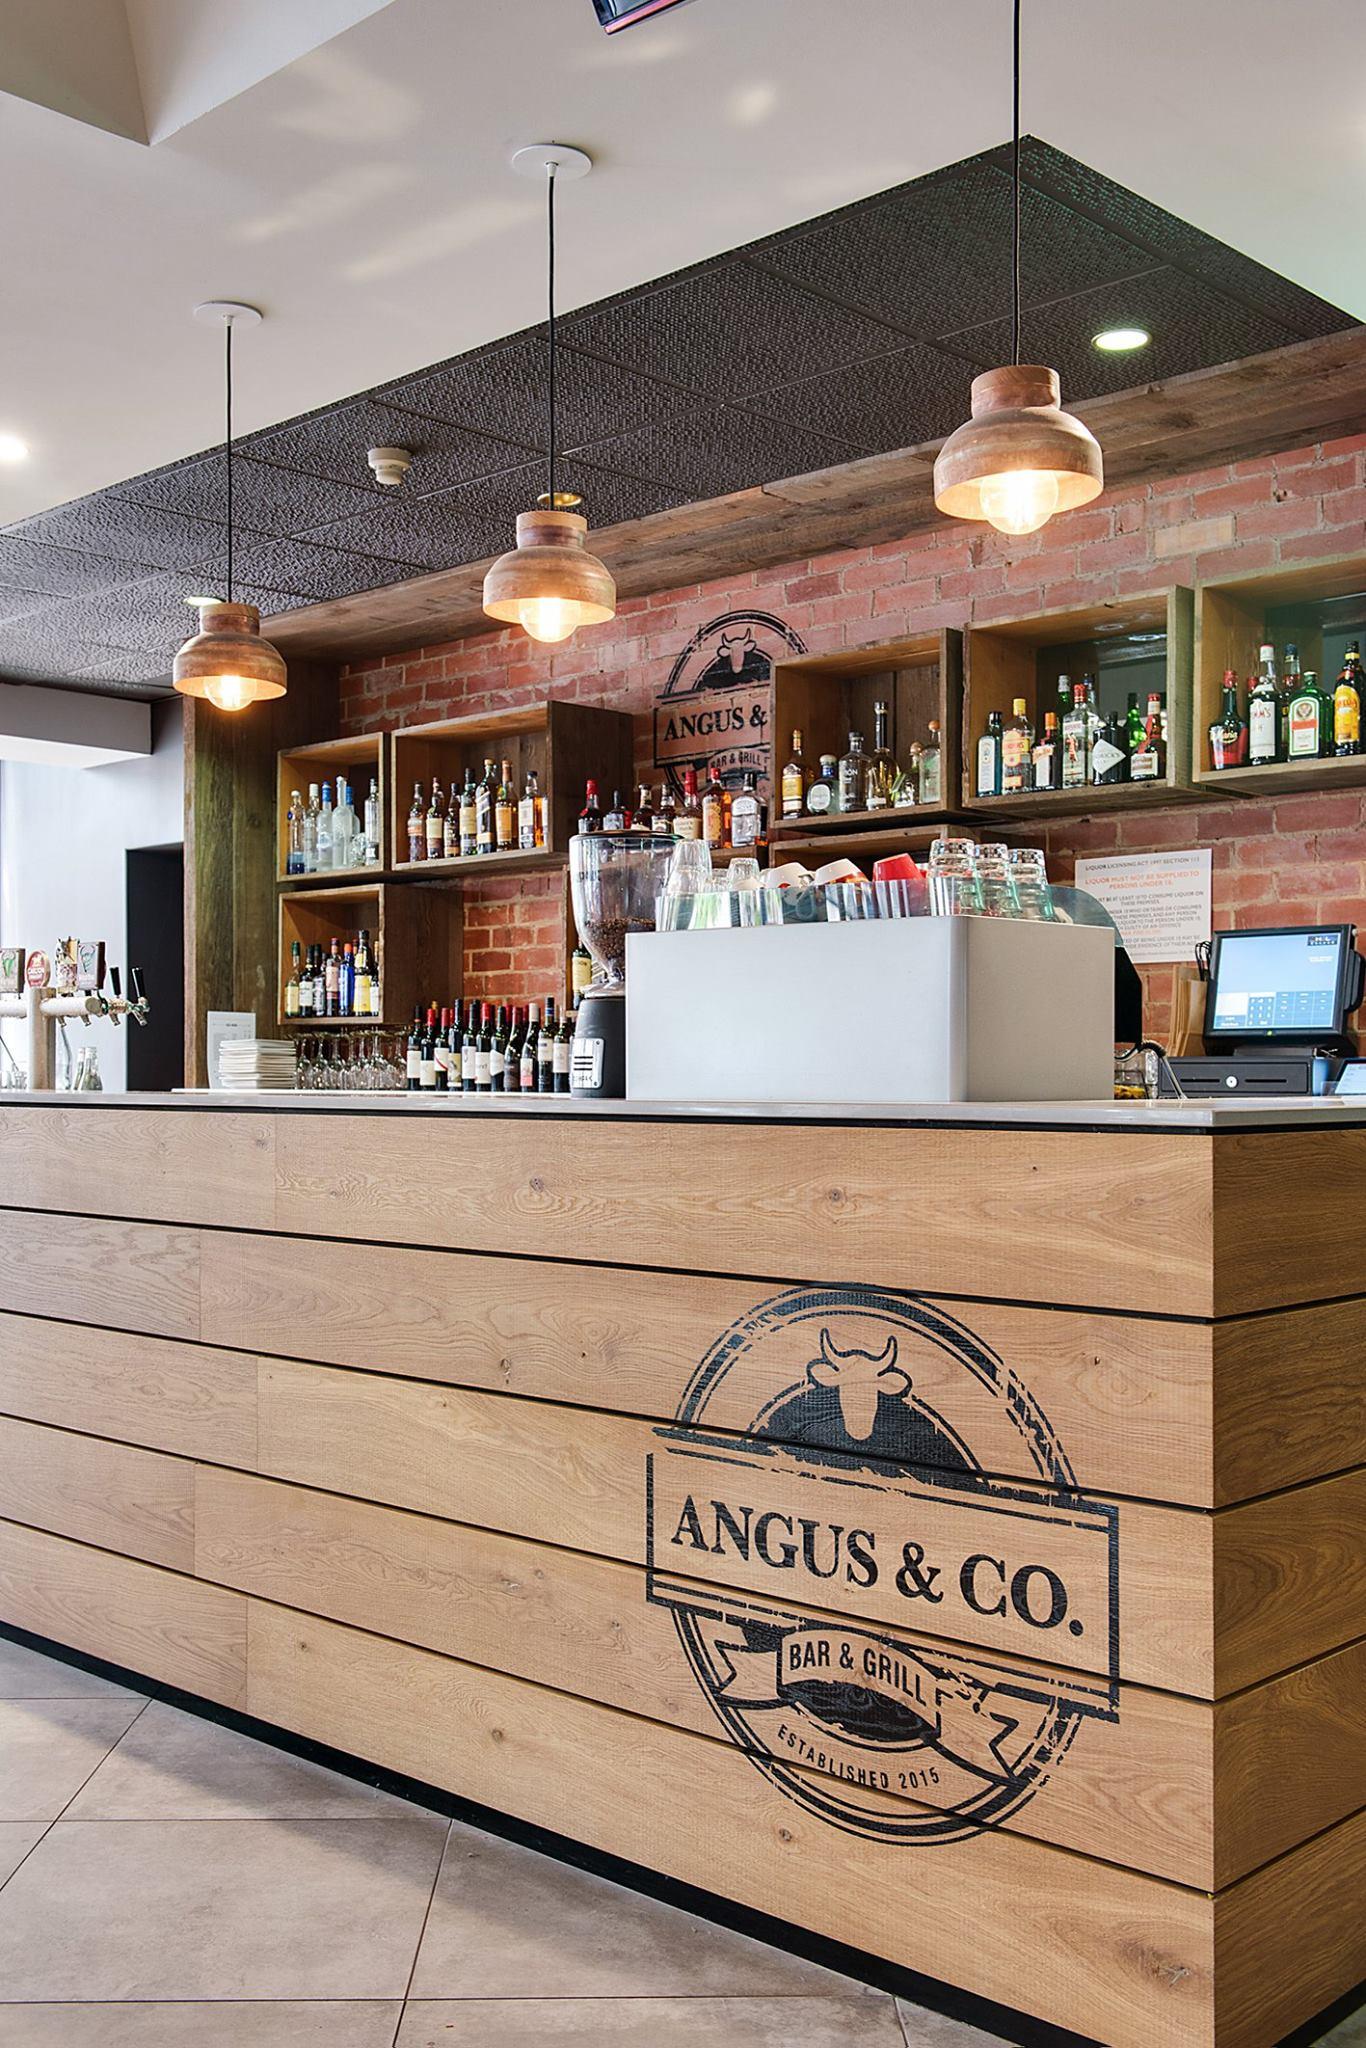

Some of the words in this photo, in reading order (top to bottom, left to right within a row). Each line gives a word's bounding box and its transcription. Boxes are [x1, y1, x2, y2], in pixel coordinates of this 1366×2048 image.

[664, 705, 744, 741] ANGUS
[749, 704, 767, 727] &
[729, 752, 736, 764] &
[738, 750, 762, 766] GRILL
[1154, 872, 1189, 880] SUPPLIED
[671, 1494, 878, 1588] ANGUS
[896, 1541, 944, 1603] &
[959, 1554, 1084, 1637] CO.
[789, 1640, 830, 1670] BAR
[839, 1642, 854, 1670] &
[863, 1647, 926, 1707] GRILL
[777, 1724, 889, 1789] ESTABLISHED
[898, 1766, 940, 1789] 2015
